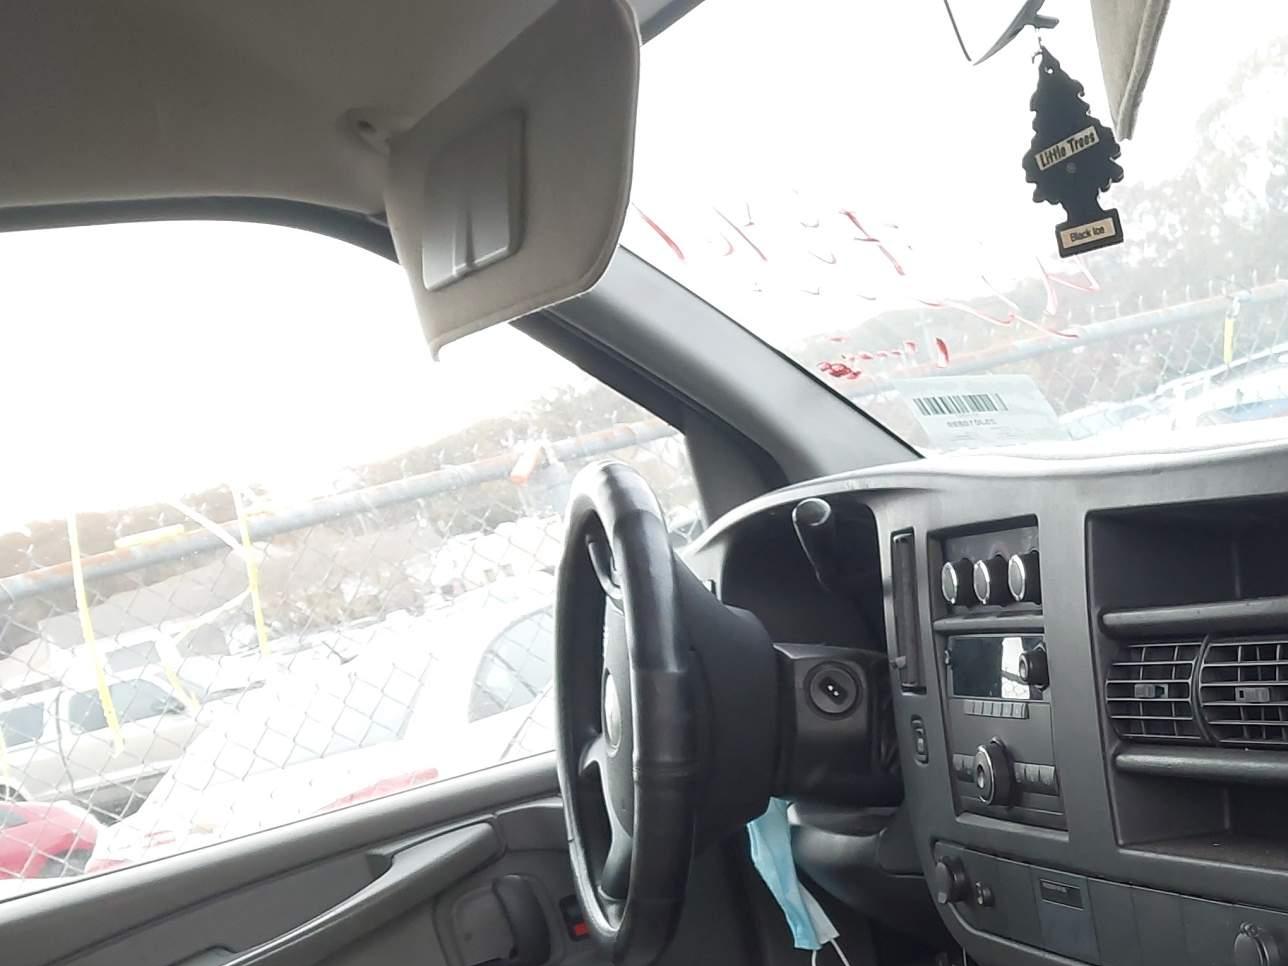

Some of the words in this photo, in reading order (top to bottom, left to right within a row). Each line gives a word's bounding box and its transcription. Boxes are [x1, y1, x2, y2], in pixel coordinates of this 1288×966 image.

[1040, 147, 1066, 168] Little
[1067, 132, 1096, 153] Trees
[1071, 229, 1092, 242] Black
[1092, 226, 1105, 237] Ice
